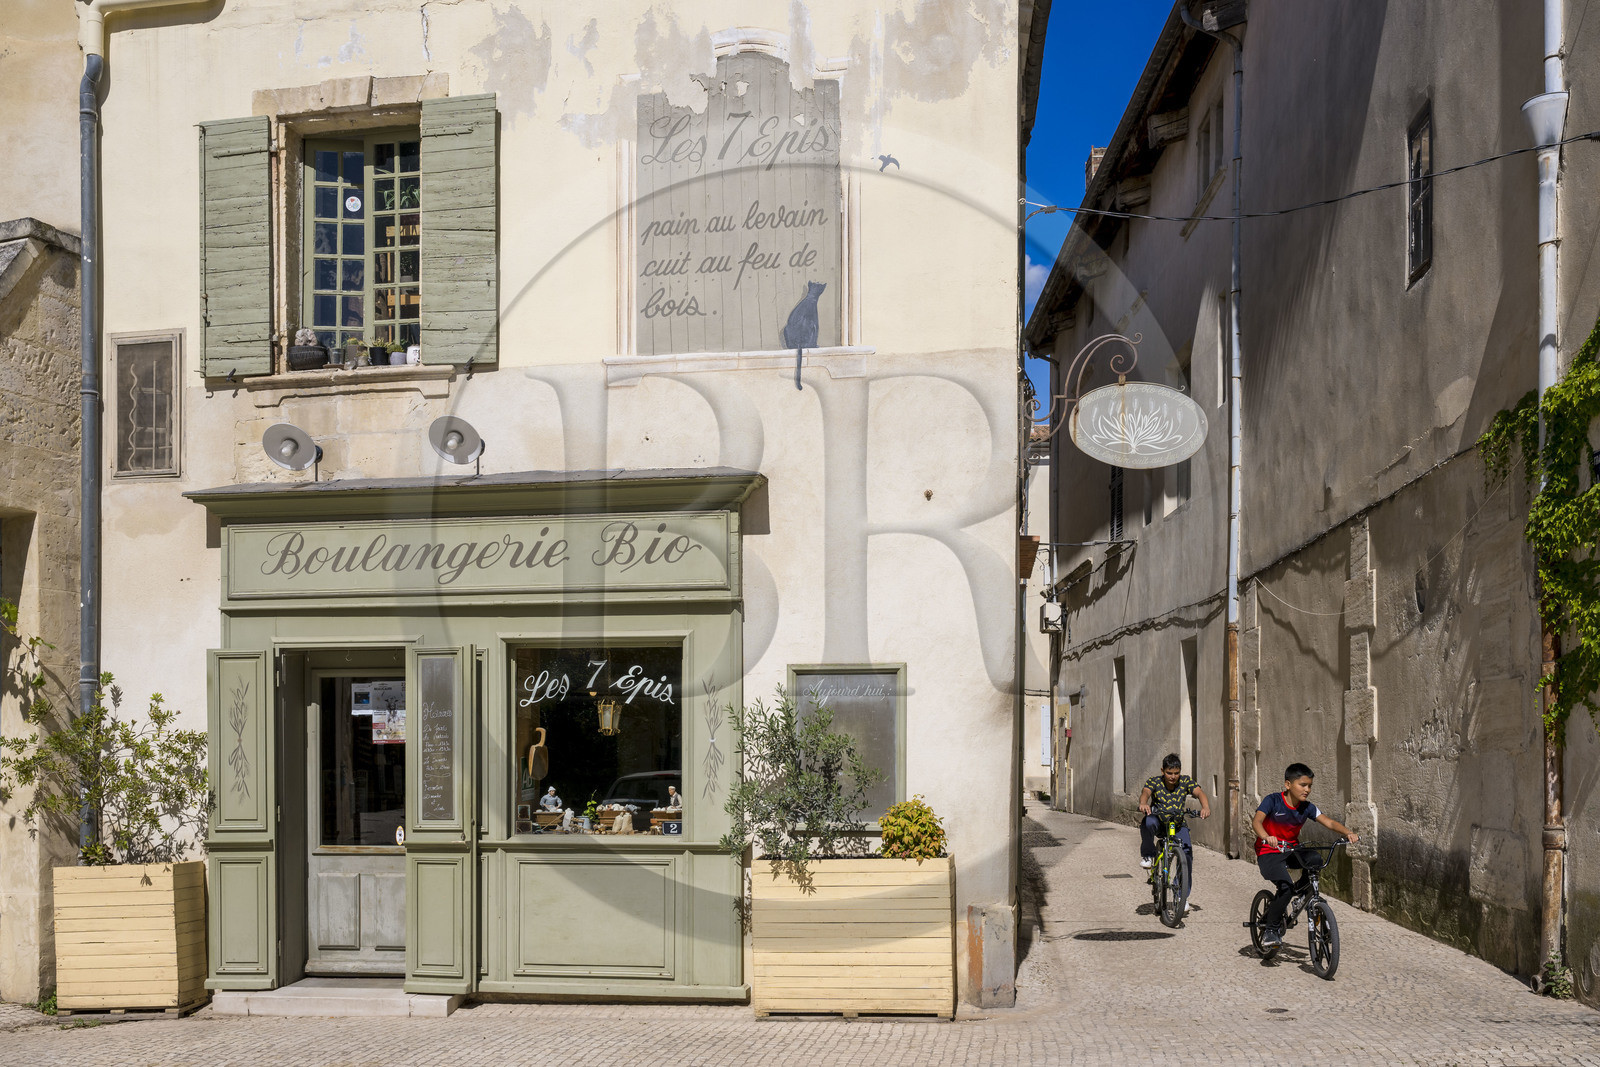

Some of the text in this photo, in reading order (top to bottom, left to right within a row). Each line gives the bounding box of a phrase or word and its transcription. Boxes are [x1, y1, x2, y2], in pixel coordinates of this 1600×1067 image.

[641, 111, 836, 173] Les 7 Epis
[641, 200, 828, 245] pain au levain
[640, 242, 817, 290] cuit au feu de
[260, 520, 702, 585] Boulangerie Bio
[519, 659, 675, 707] Les 7 Epis
[669, 824, 678, 834] 2
